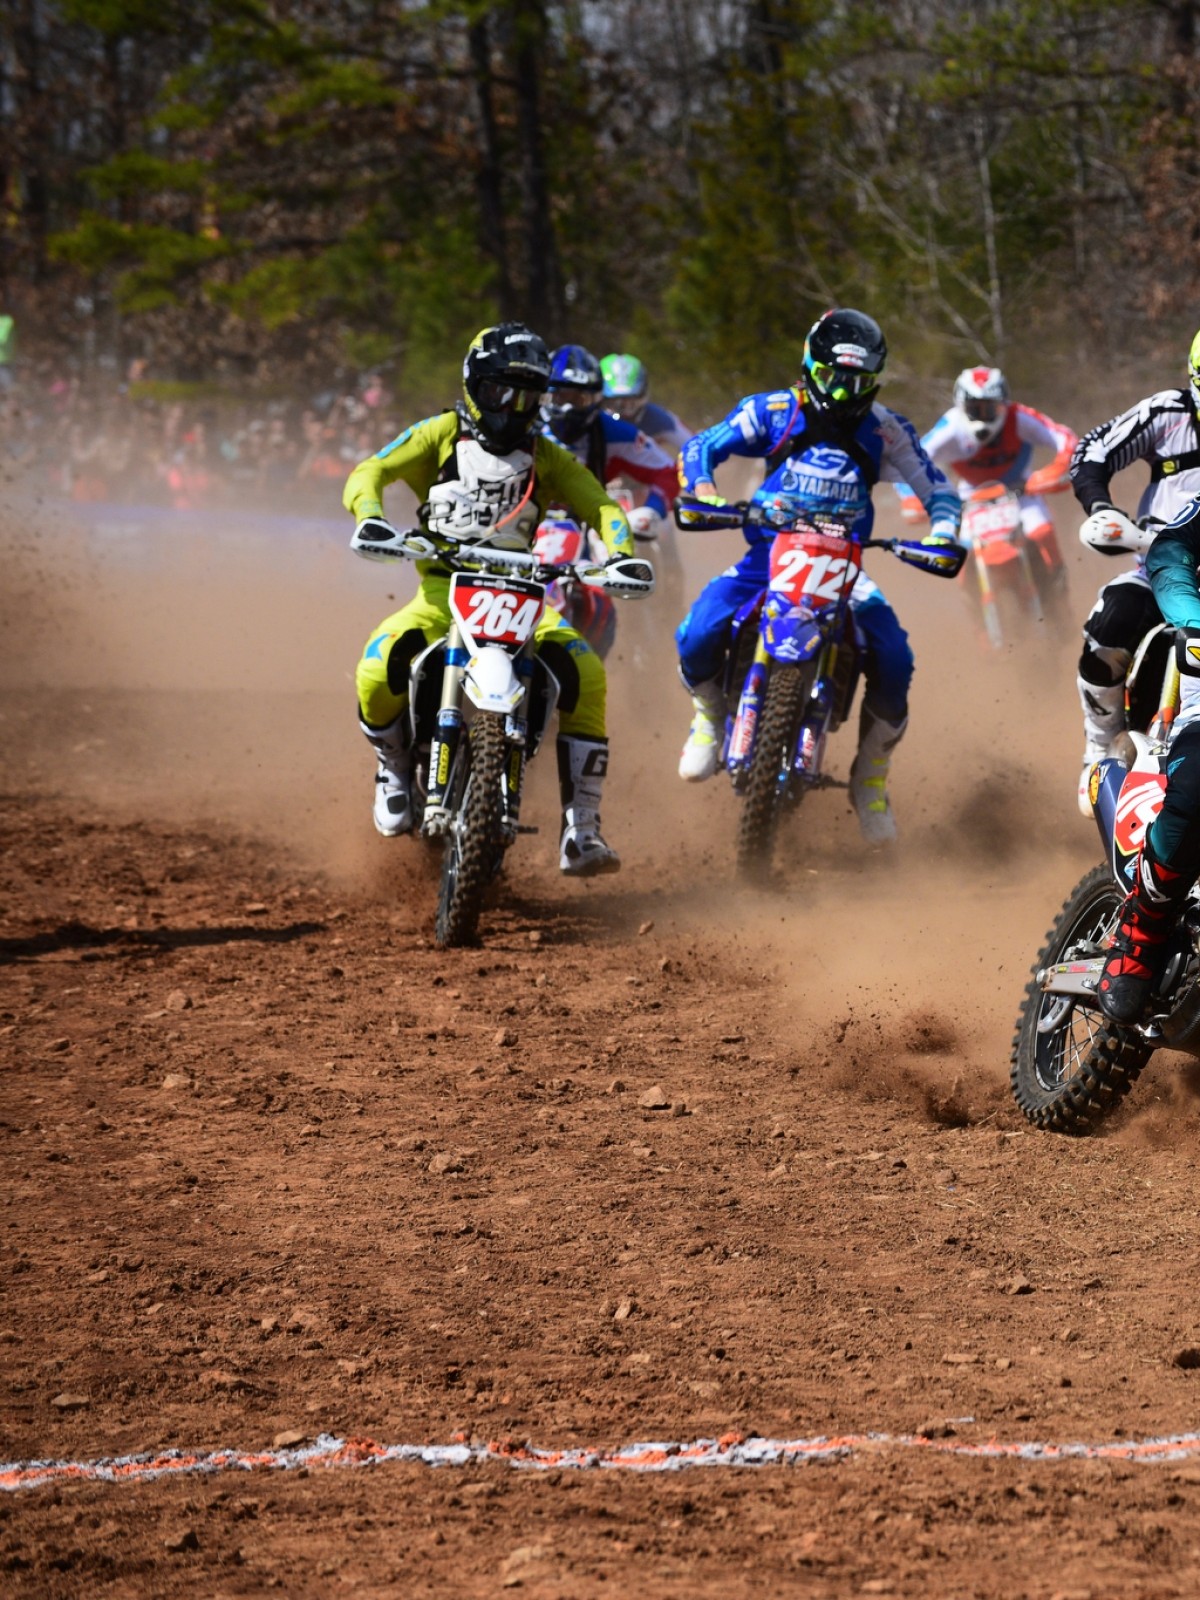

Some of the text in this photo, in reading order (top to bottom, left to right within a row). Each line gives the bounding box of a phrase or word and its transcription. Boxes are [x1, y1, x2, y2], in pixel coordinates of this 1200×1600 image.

[799, 474, 860, 501] YAMAHA
[770, 549, 859, 601] 212
[463, 590, 540, 641] 264
